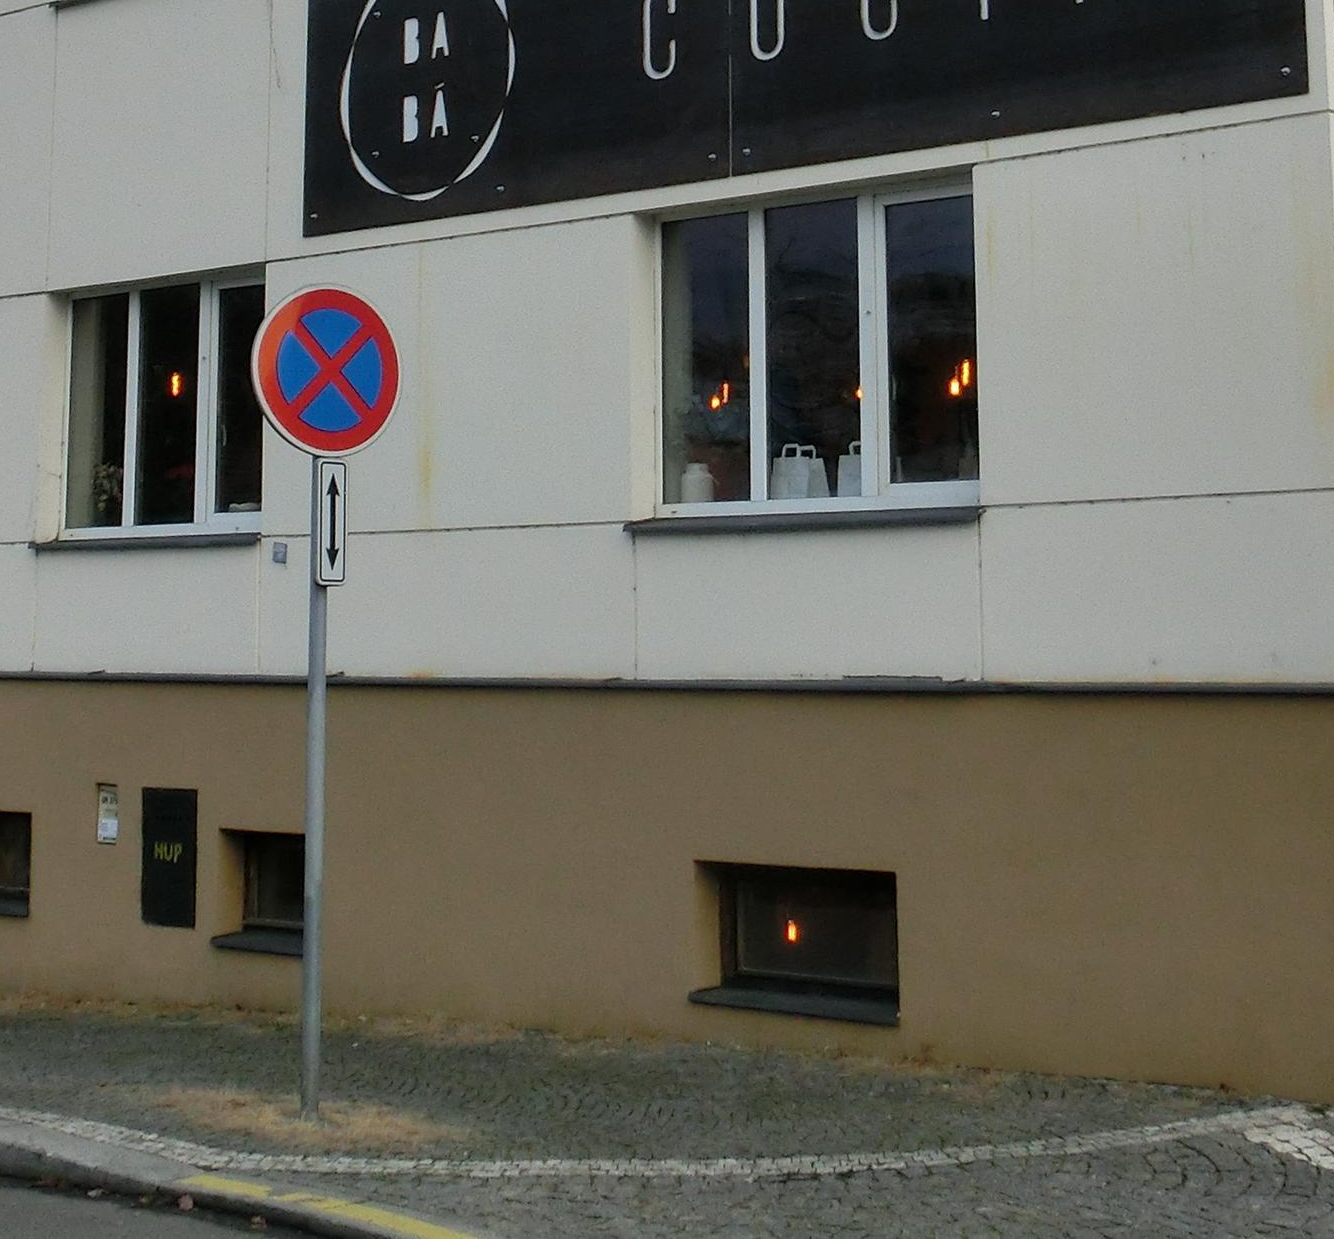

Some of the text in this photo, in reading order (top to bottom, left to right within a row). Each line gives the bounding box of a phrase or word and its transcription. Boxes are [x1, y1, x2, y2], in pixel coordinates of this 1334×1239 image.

[403, 11, 450, 65] BA
[402, 81, 450, 143] BÁ
[154, 841, 183, 864] HUP
